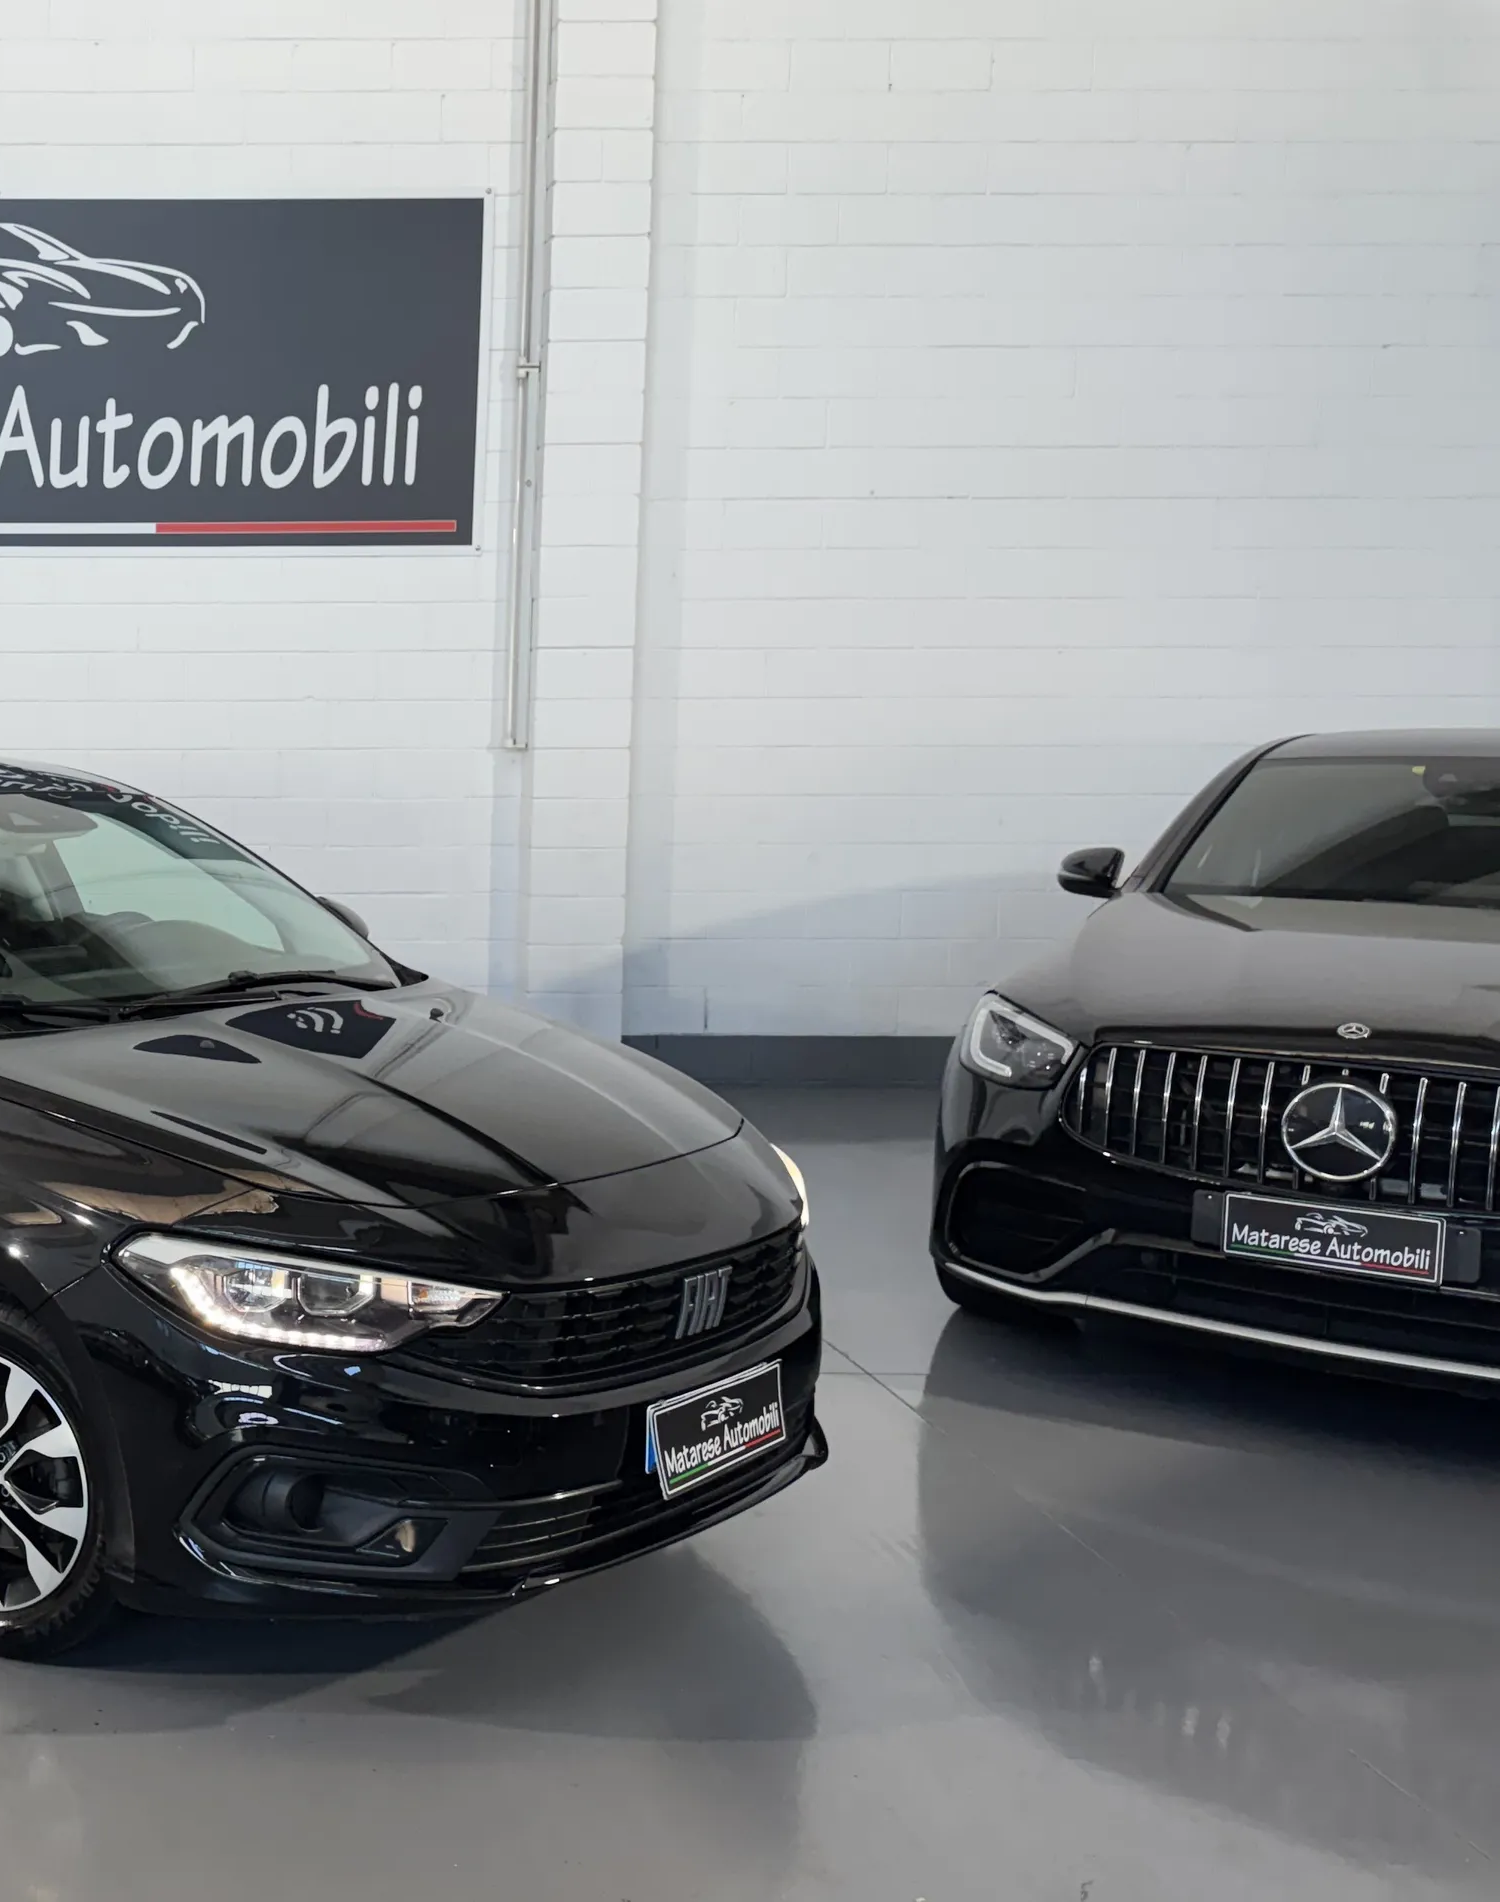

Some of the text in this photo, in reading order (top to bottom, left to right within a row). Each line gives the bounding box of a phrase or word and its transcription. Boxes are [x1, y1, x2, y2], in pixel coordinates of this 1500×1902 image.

[1232, 1222, 1431, 1271] Matarese Automobili
[675, 1265, 733, 1339] FIAT
[664, 1401, 780, 1477] Matarese Automobili
